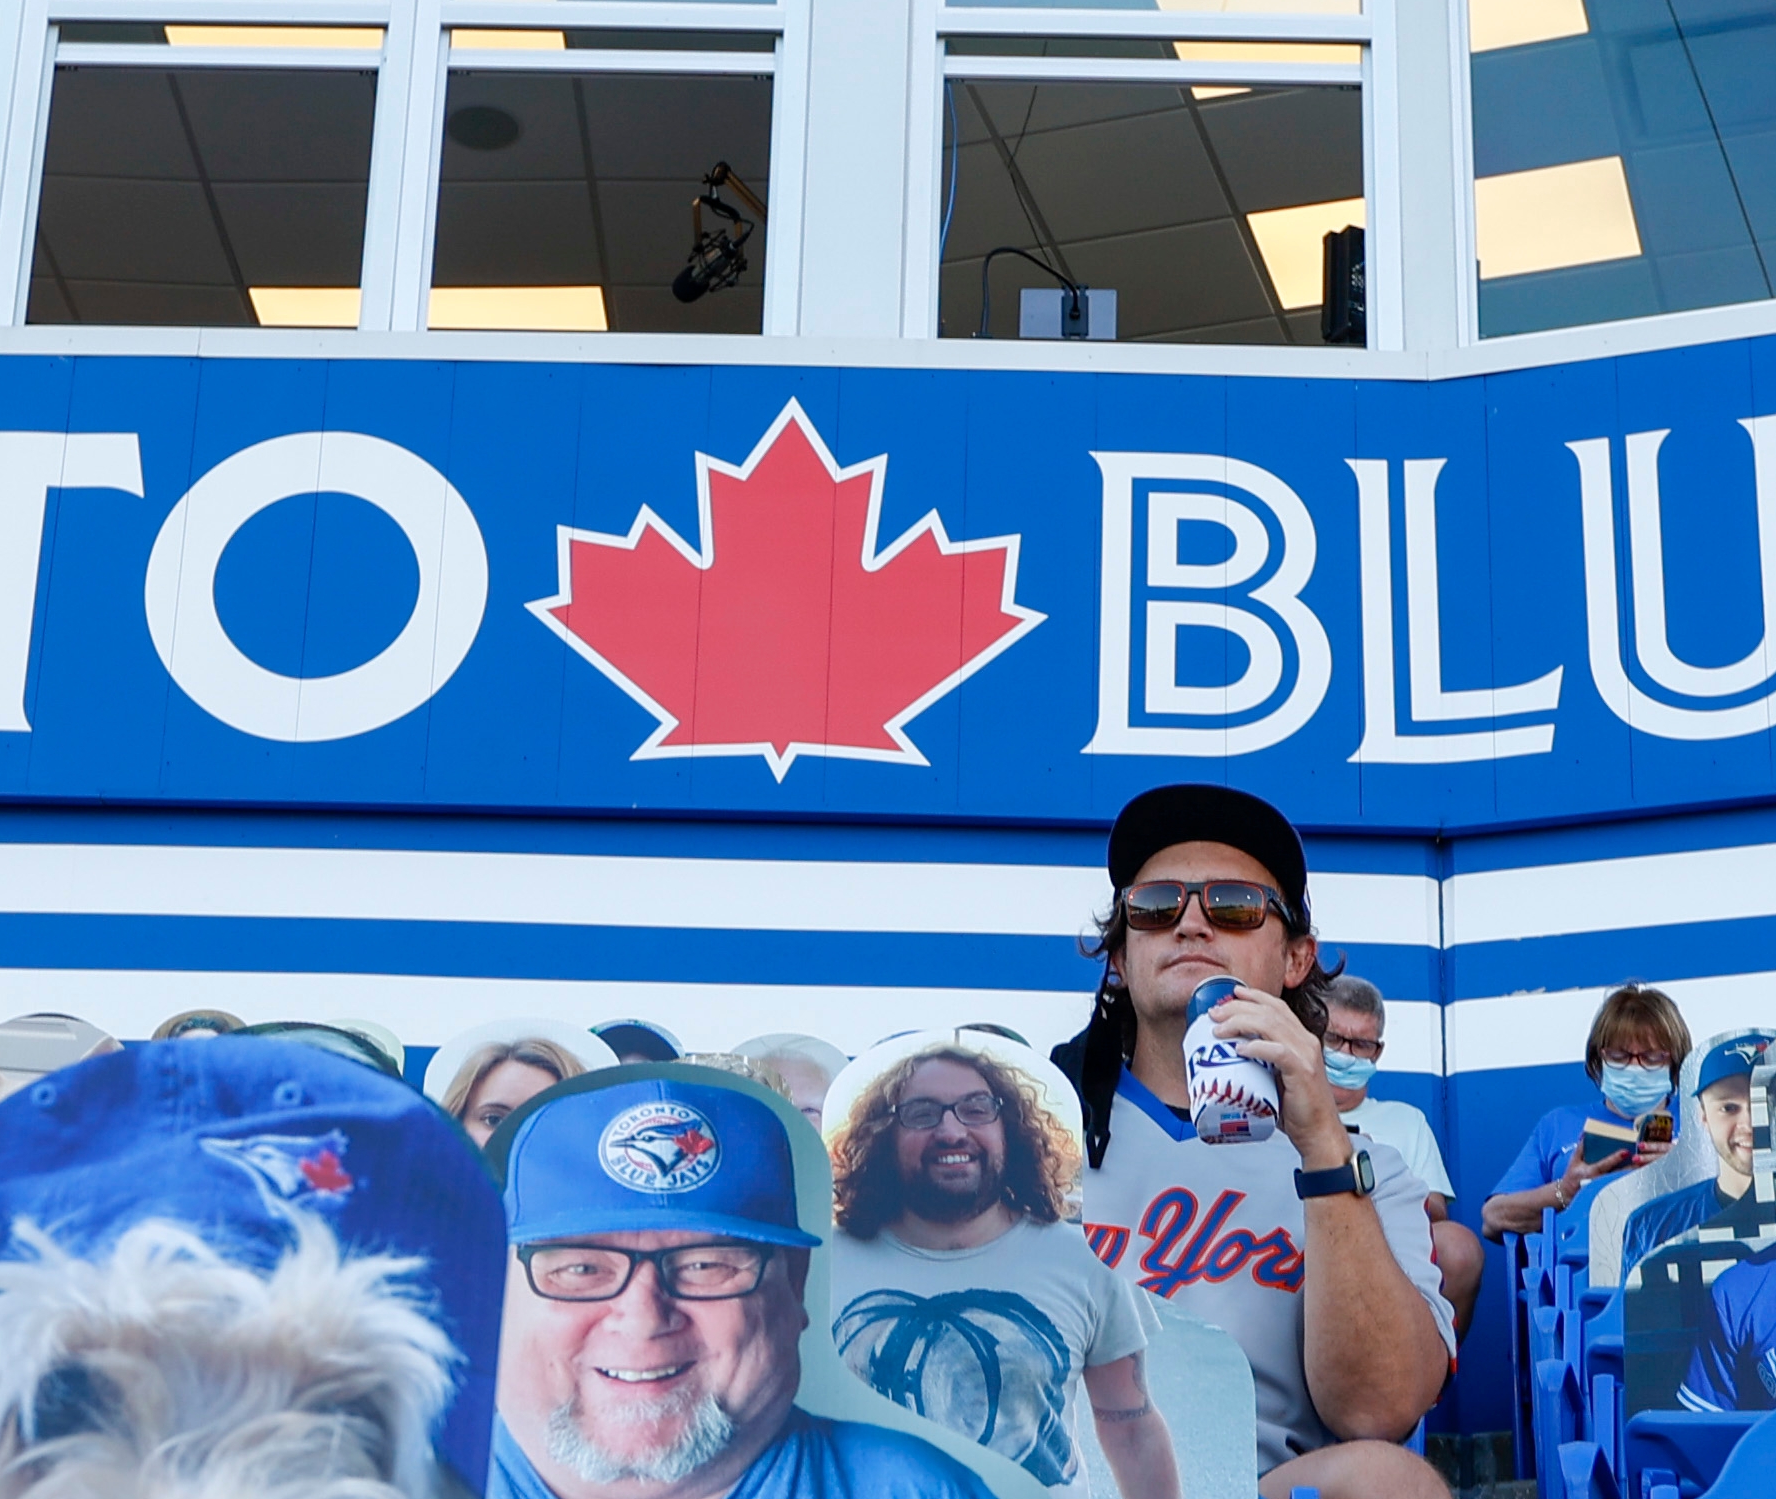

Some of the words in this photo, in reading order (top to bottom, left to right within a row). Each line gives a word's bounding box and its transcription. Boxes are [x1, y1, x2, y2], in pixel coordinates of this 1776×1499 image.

[614, 1106, 691, 1138] TORONTO
[609, 1153, 657, 1187] BLUE
[668, 1159, 711, 1187] JAYS
[1137, 1185, 1305, 1299] Yor
